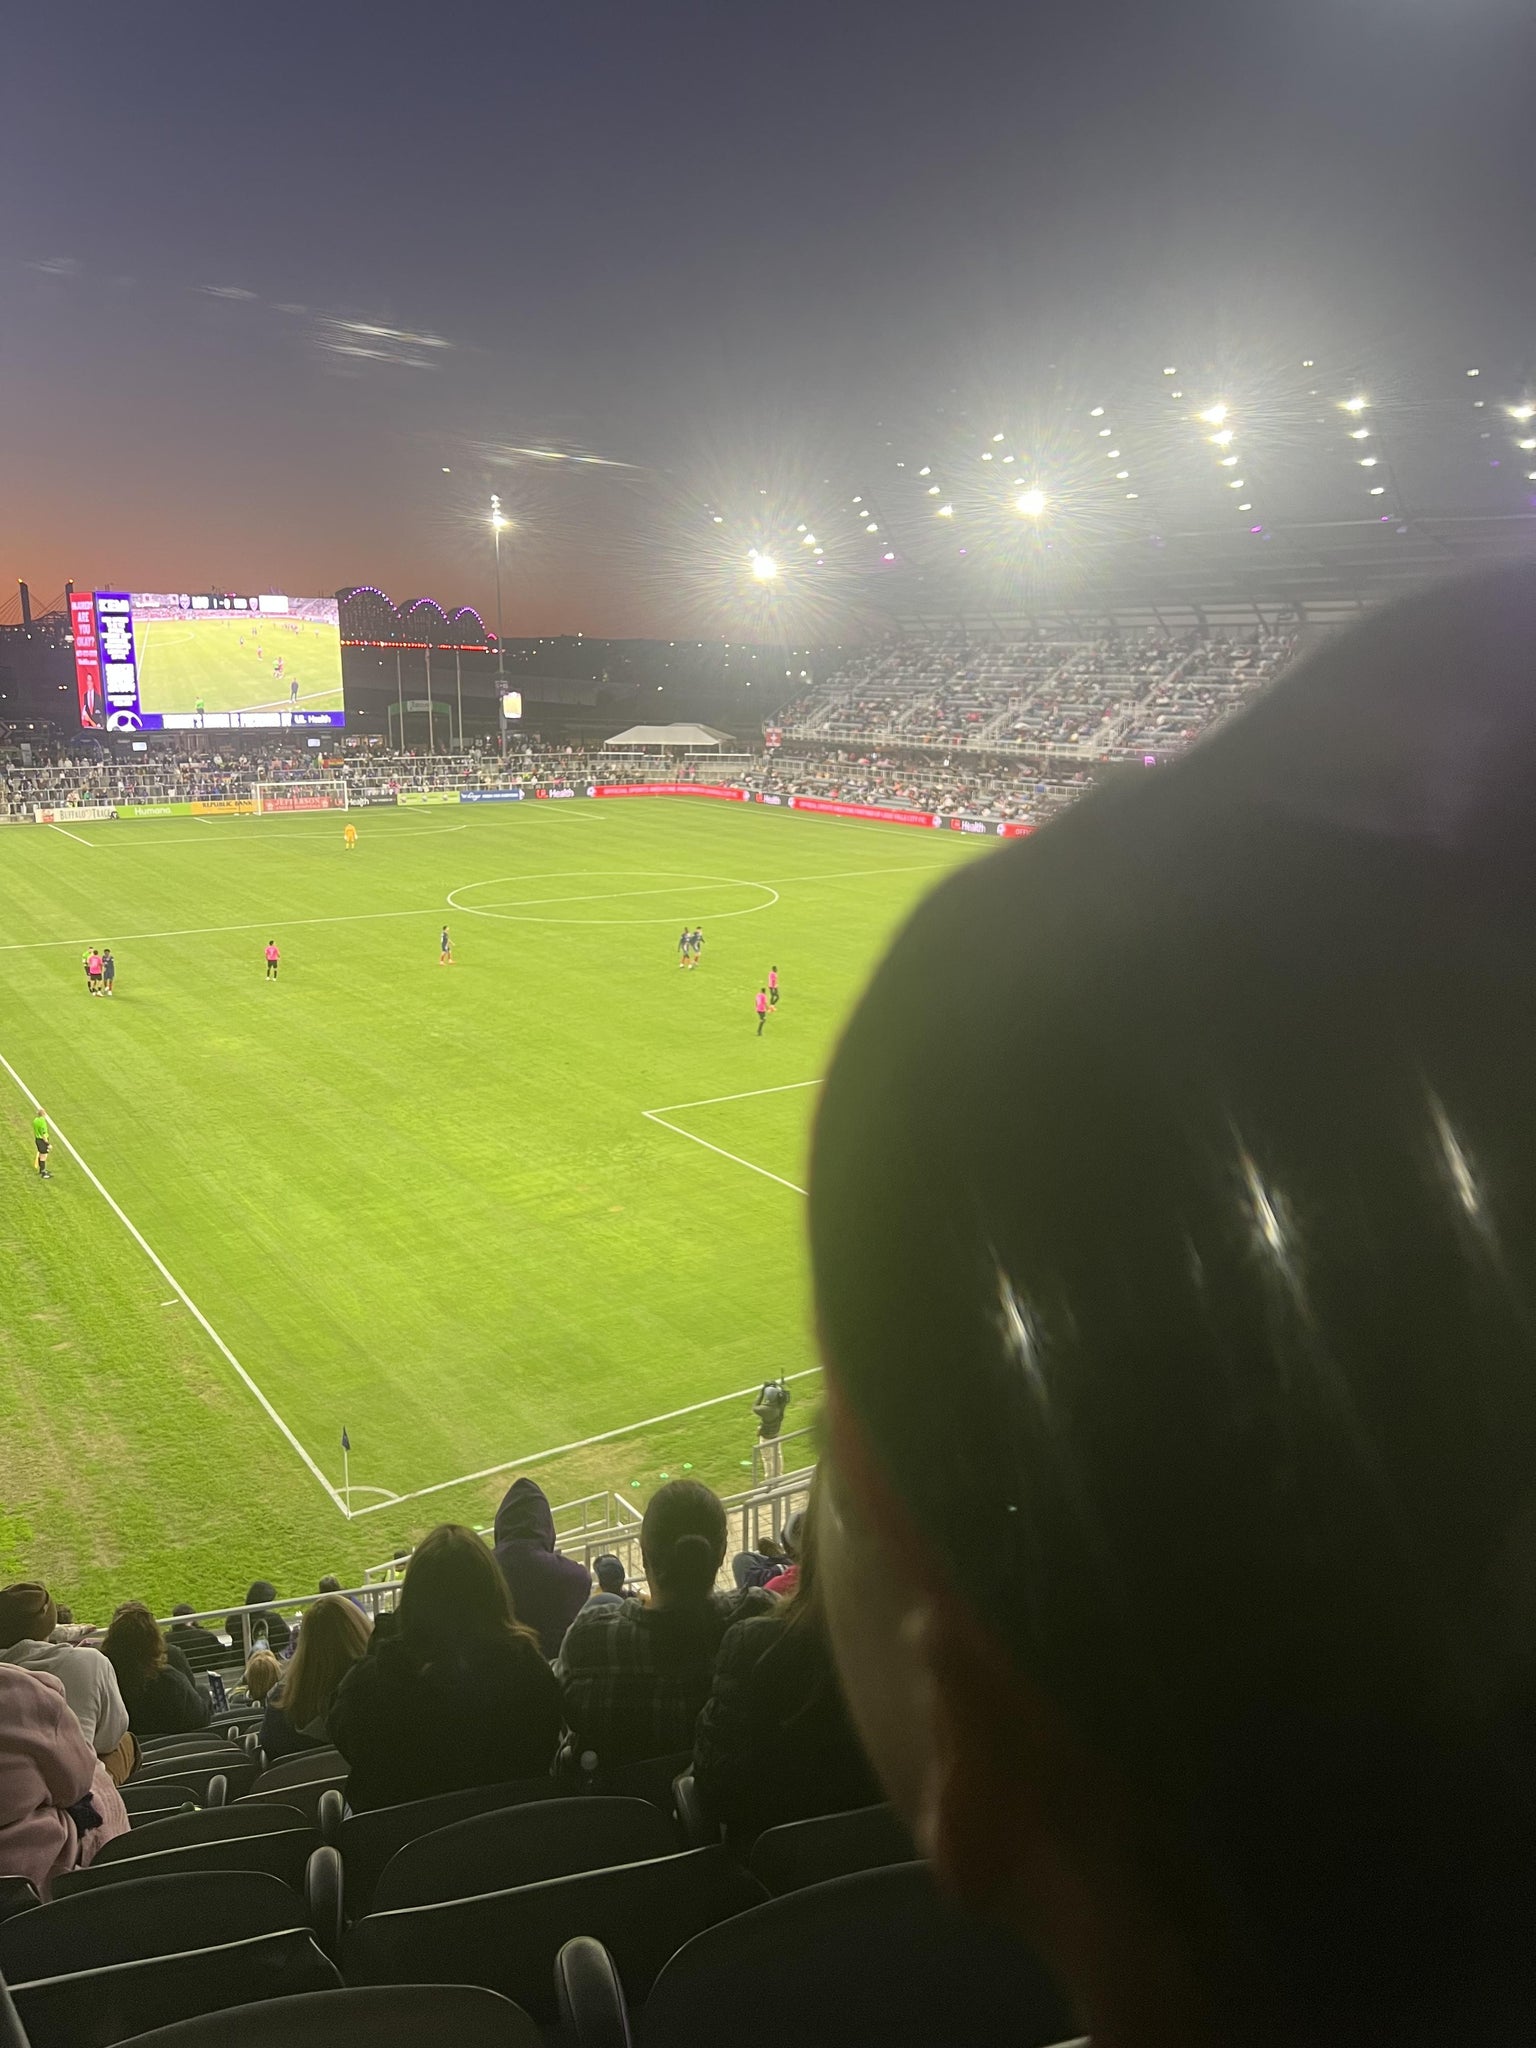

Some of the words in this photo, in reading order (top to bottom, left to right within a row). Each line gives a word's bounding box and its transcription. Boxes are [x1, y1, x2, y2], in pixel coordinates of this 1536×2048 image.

[77, 612, 90, 622] ARE
[78, 624, 91, 635] YOU
[549, 788, 575, 798] Health
[202, 800, 233, 808] REPUBLIC
[60, 809, 86, 820] BUFFALO
[134, 806, 172, 816] Humana
[961, 820, 986, 833] Health
